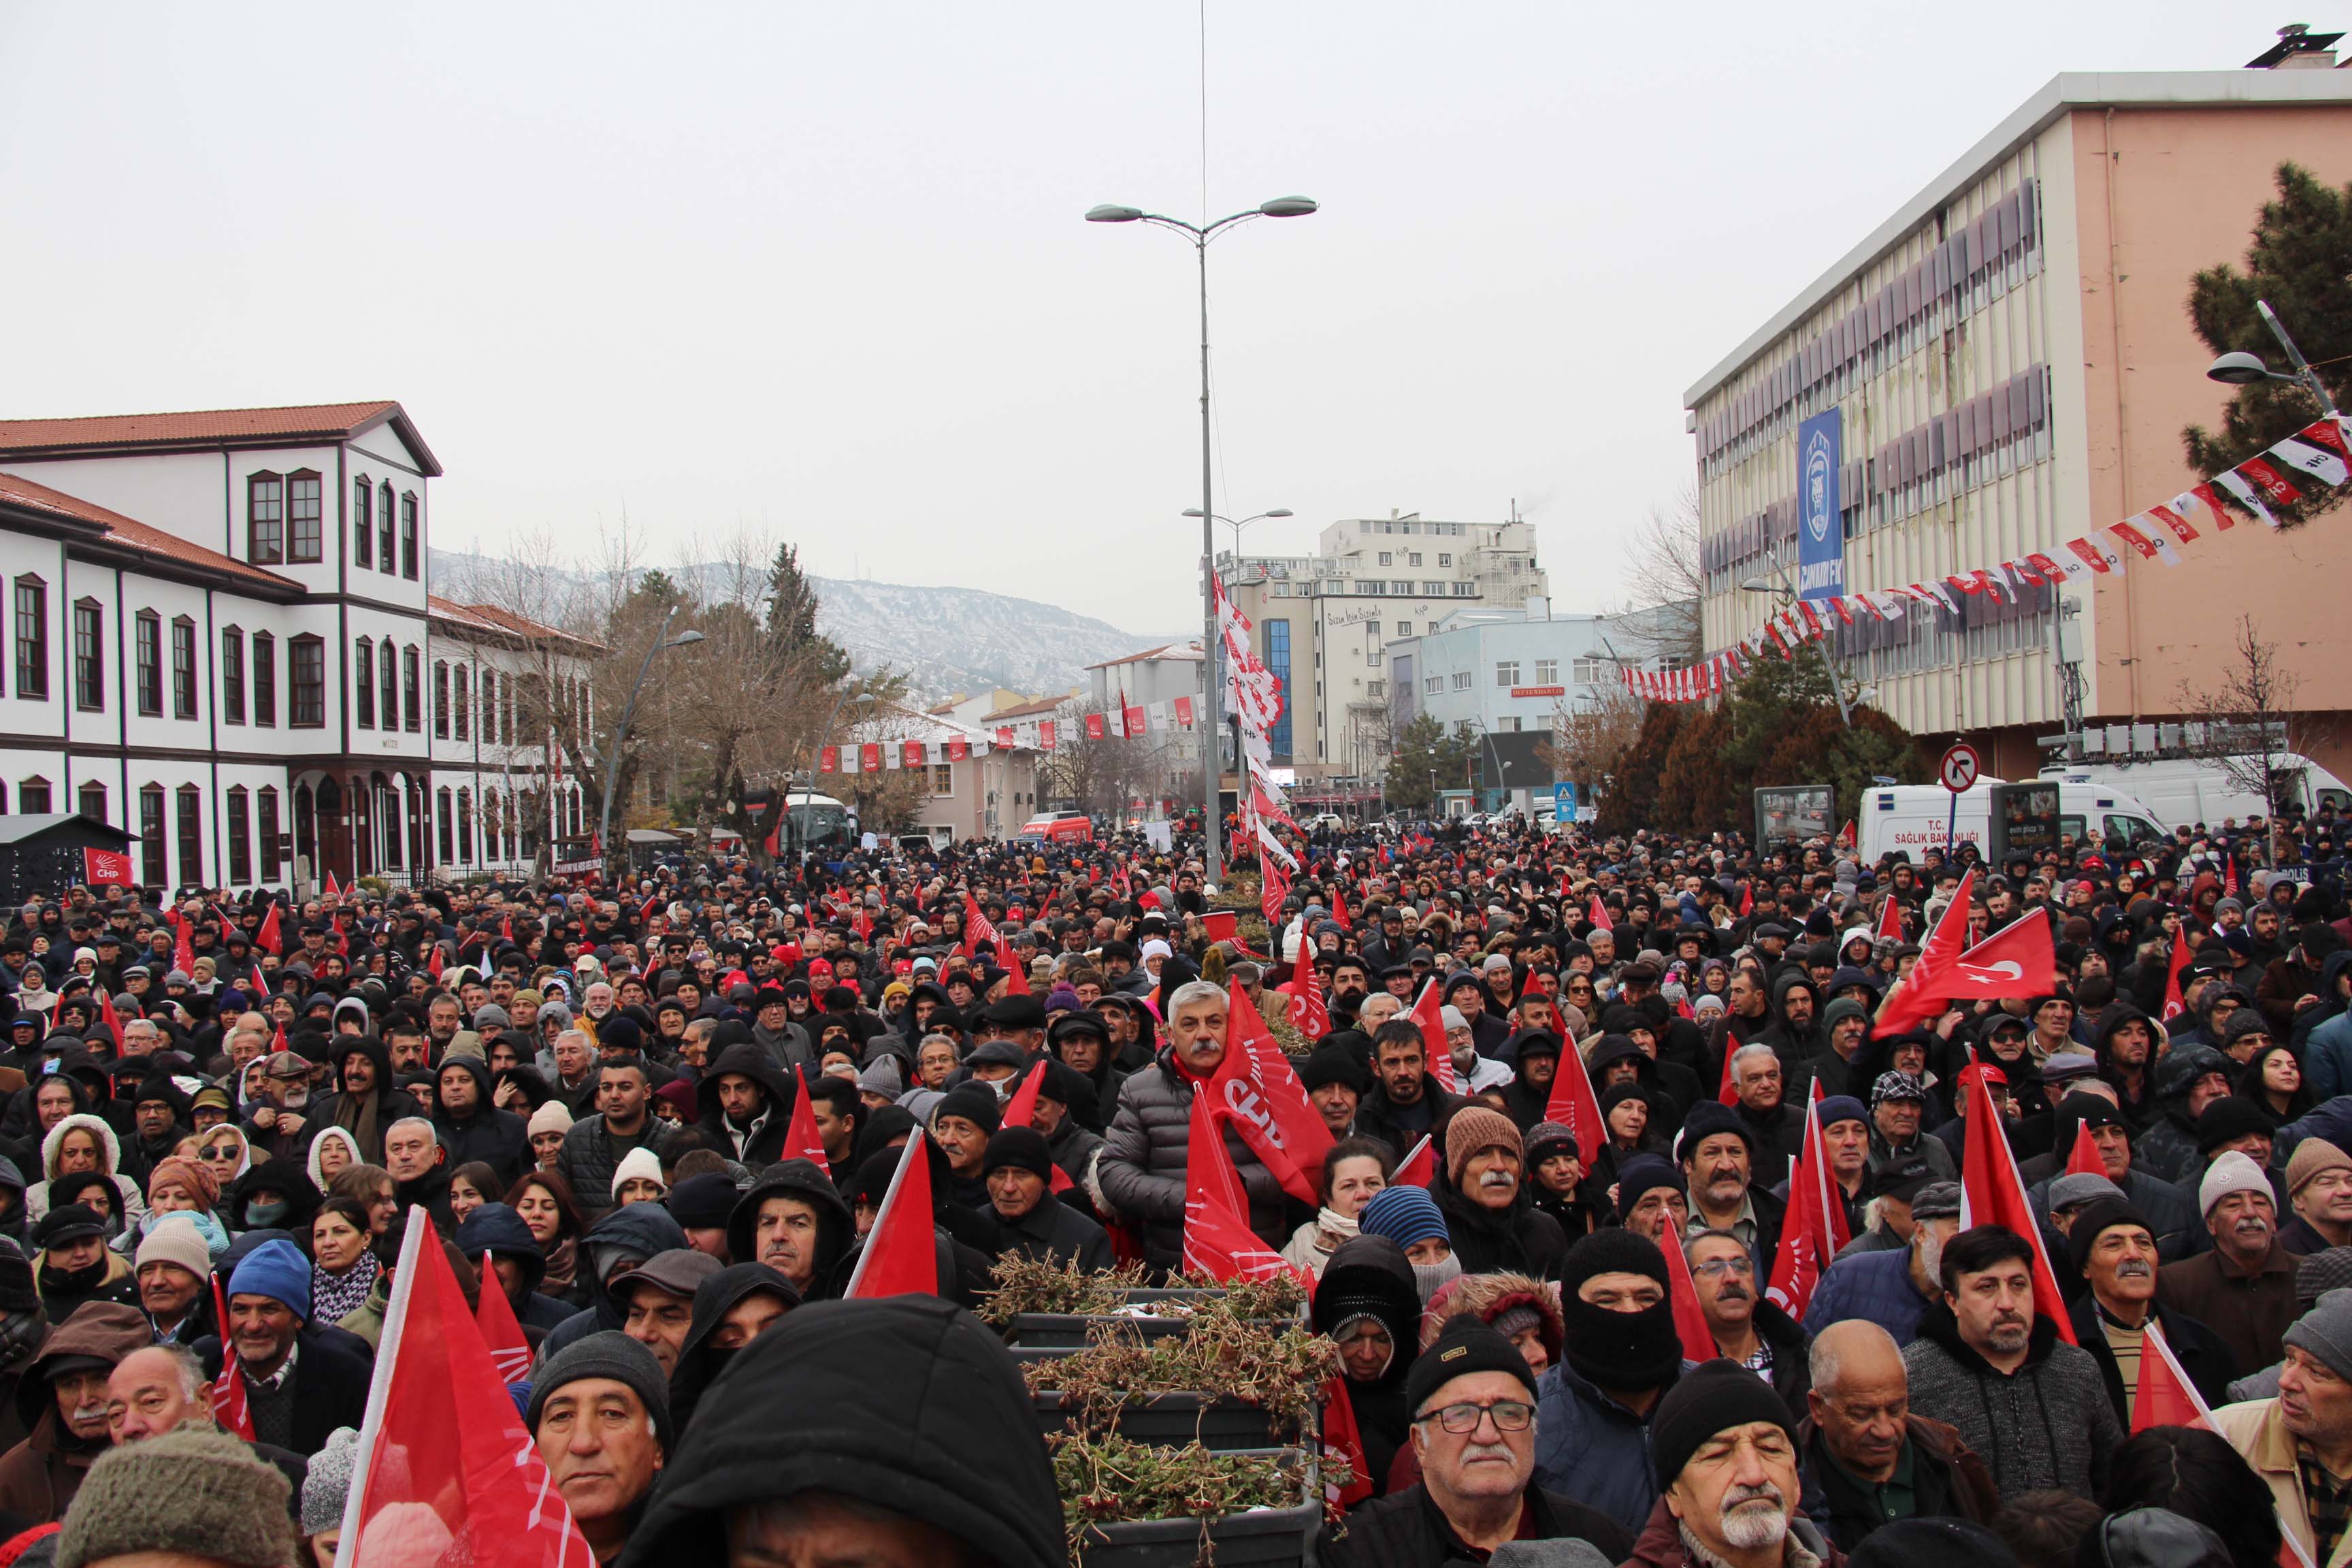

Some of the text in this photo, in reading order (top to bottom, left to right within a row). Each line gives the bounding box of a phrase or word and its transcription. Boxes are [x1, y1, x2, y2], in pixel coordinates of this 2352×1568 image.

[1830, 558, 1842, 585] FK
[1327, 604, 1382, 625] Sizin İçin Sizinle
[382, 737, 398, 749] MÜZE
[1927, 819, 1945, 831] T.C.
[1895, 830, 1979, 844] SAĞLIK BAKNLIĞI
[97, 868, 119, 879] CHP
